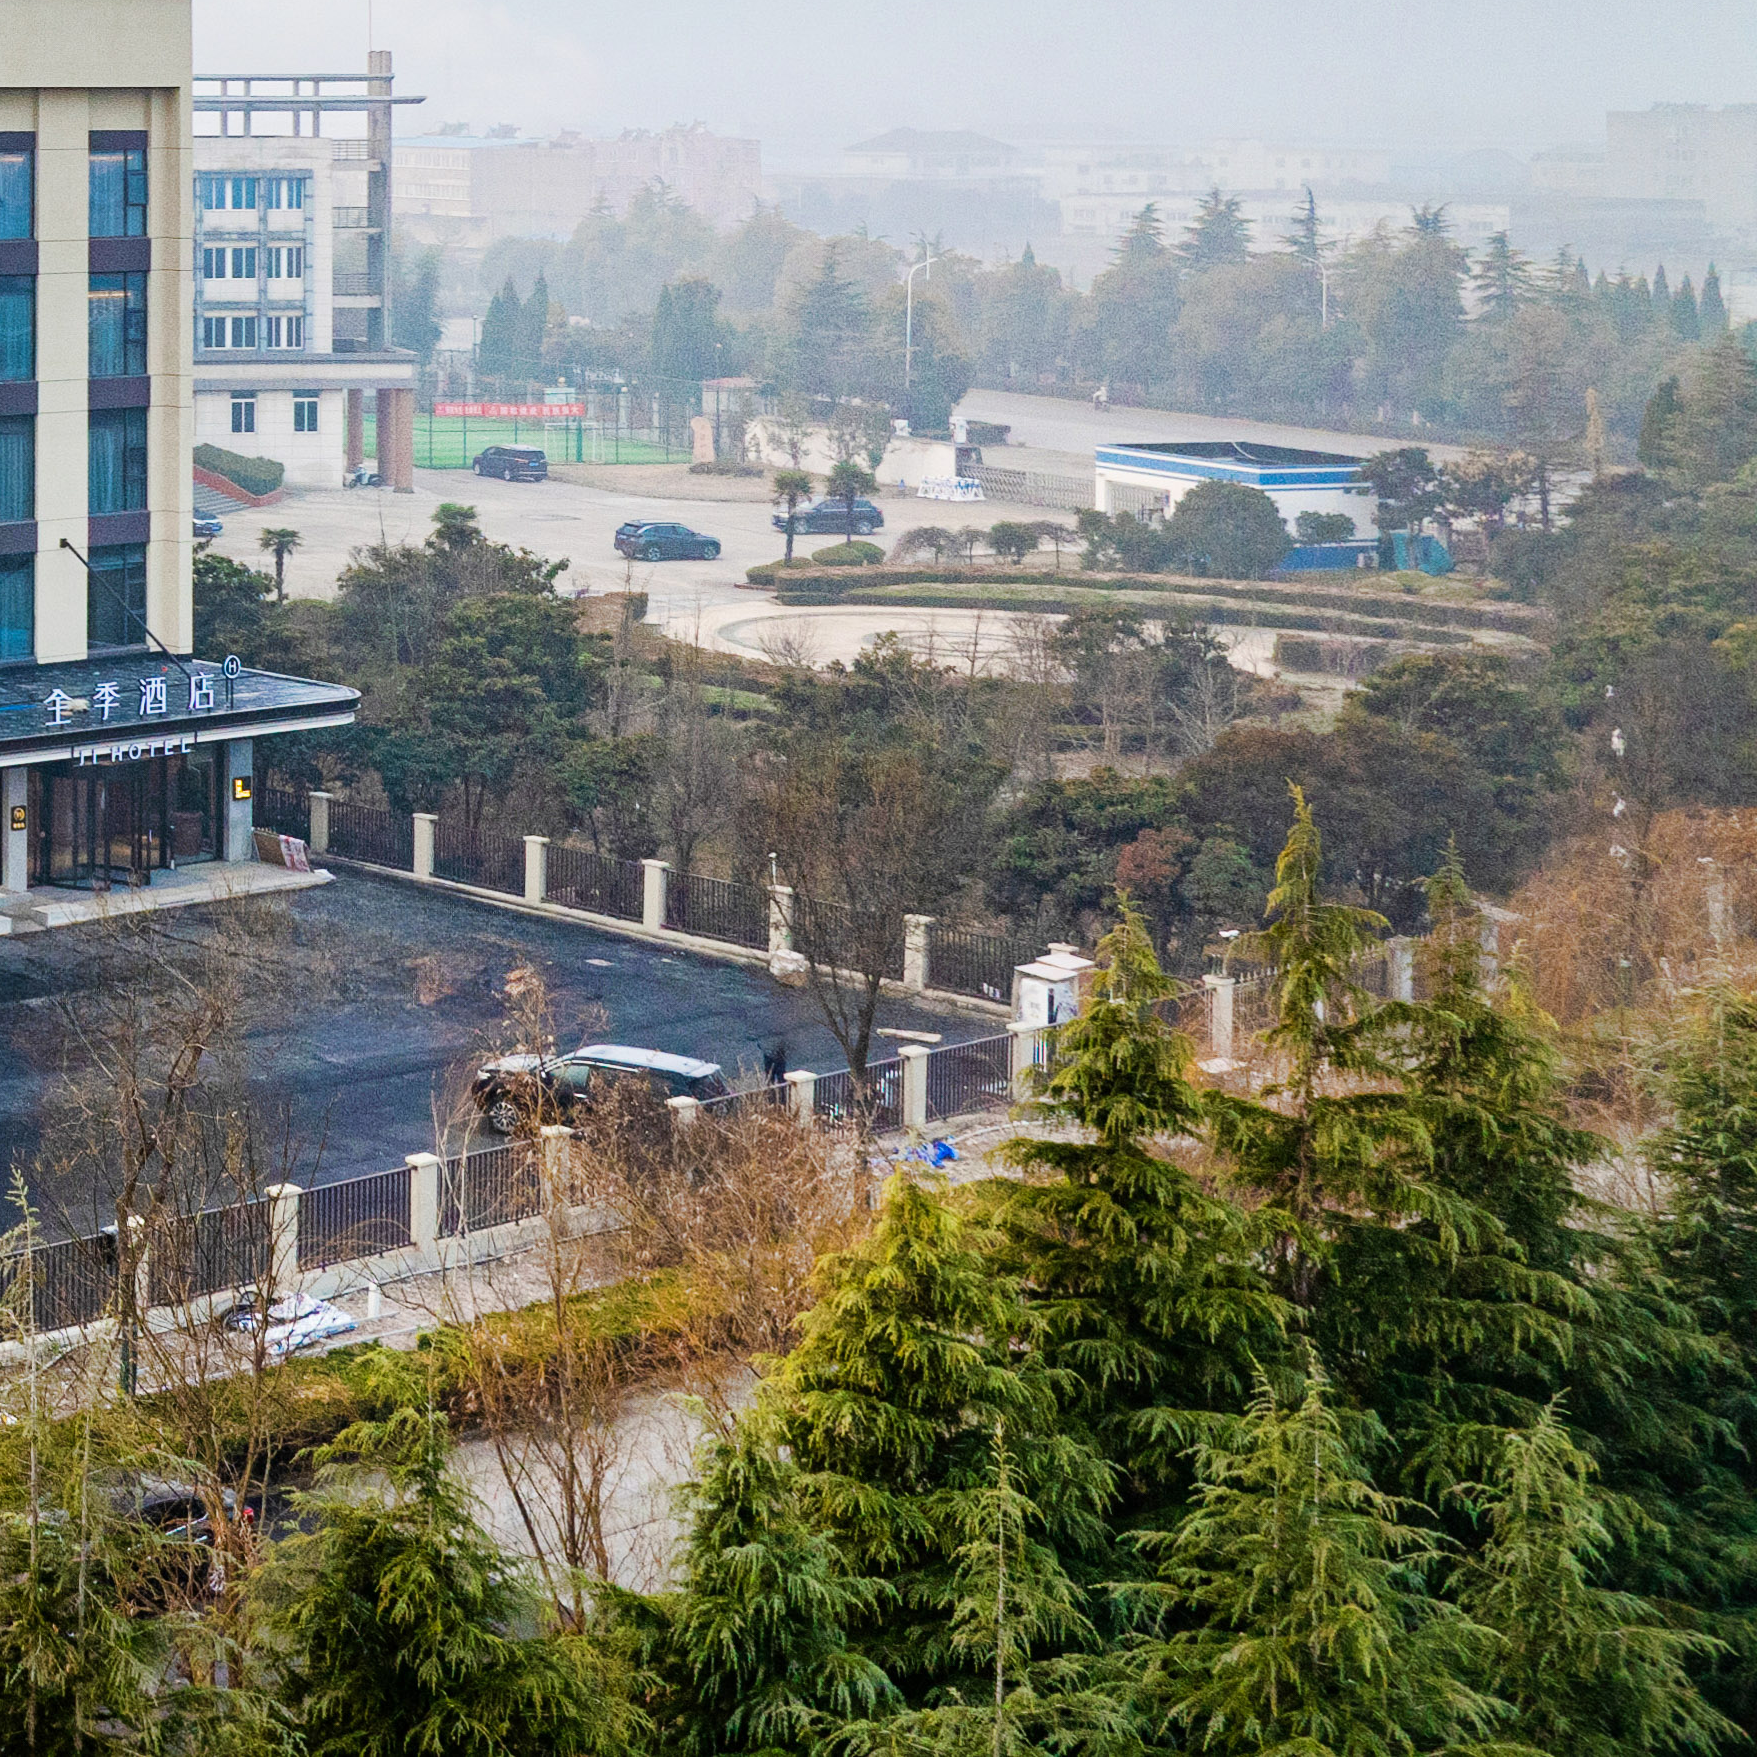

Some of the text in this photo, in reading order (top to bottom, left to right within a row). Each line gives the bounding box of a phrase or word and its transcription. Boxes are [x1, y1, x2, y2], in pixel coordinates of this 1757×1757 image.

[43, 671, 215, 726] 全季酒店
[79, 738, 192, 767] JI HOTEL
